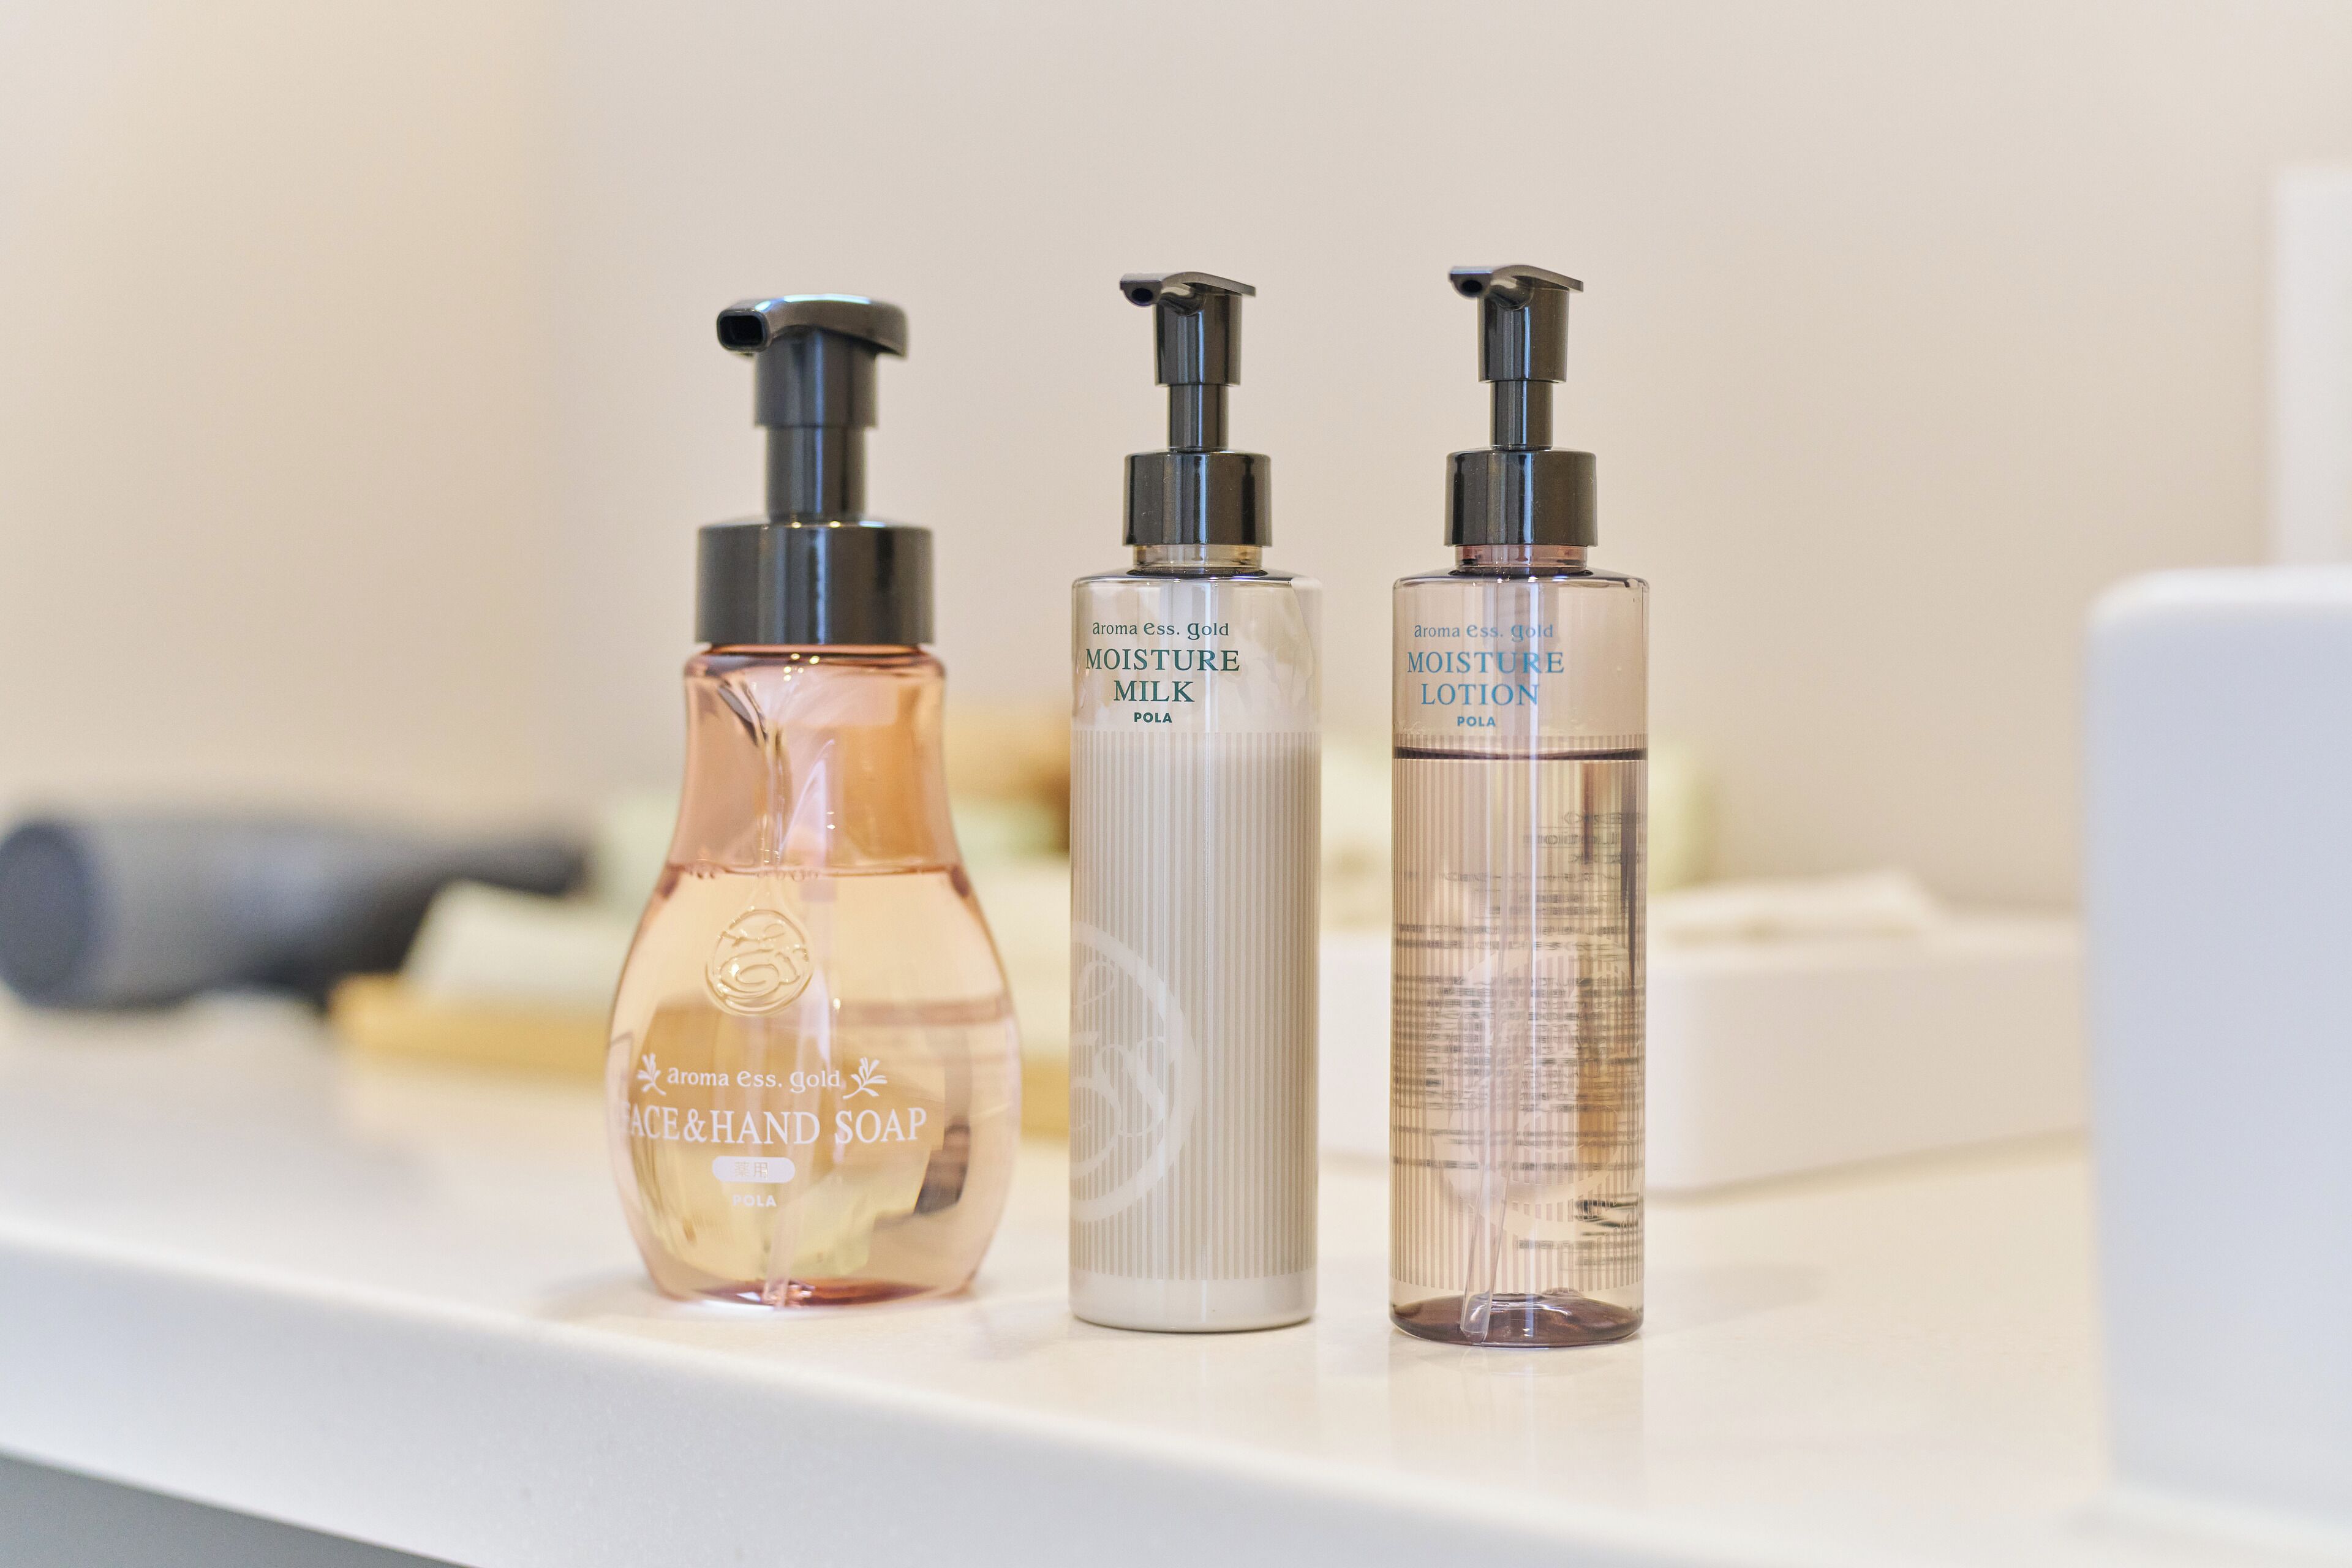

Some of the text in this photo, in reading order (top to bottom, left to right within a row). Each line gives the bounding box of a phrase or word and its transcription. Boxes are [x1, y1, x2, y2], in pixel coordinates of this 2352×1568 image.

[1092, 622, 1229, 641] aroma ess. gold
[1414, 624, 1553, 643] aroma ess. gold
[1085, 648, 1240, 672] MOISTURE
[1407, 651, 1565, 674] MOISTURE
[1113, 680, 1196, 703] MILK
[1421, 683, 1540, 706] LOTION
[1134, 712, 1173, 724] POLA
[1457, 715, 1496, 727] POLA
[666, 1066, 841, 1095] aroma ess. gold
[834, 1106, 927, 1146] SOAP
[734, 1160, 770, 1180] 薬用
[732, 1194, 777, 1208] POLA
